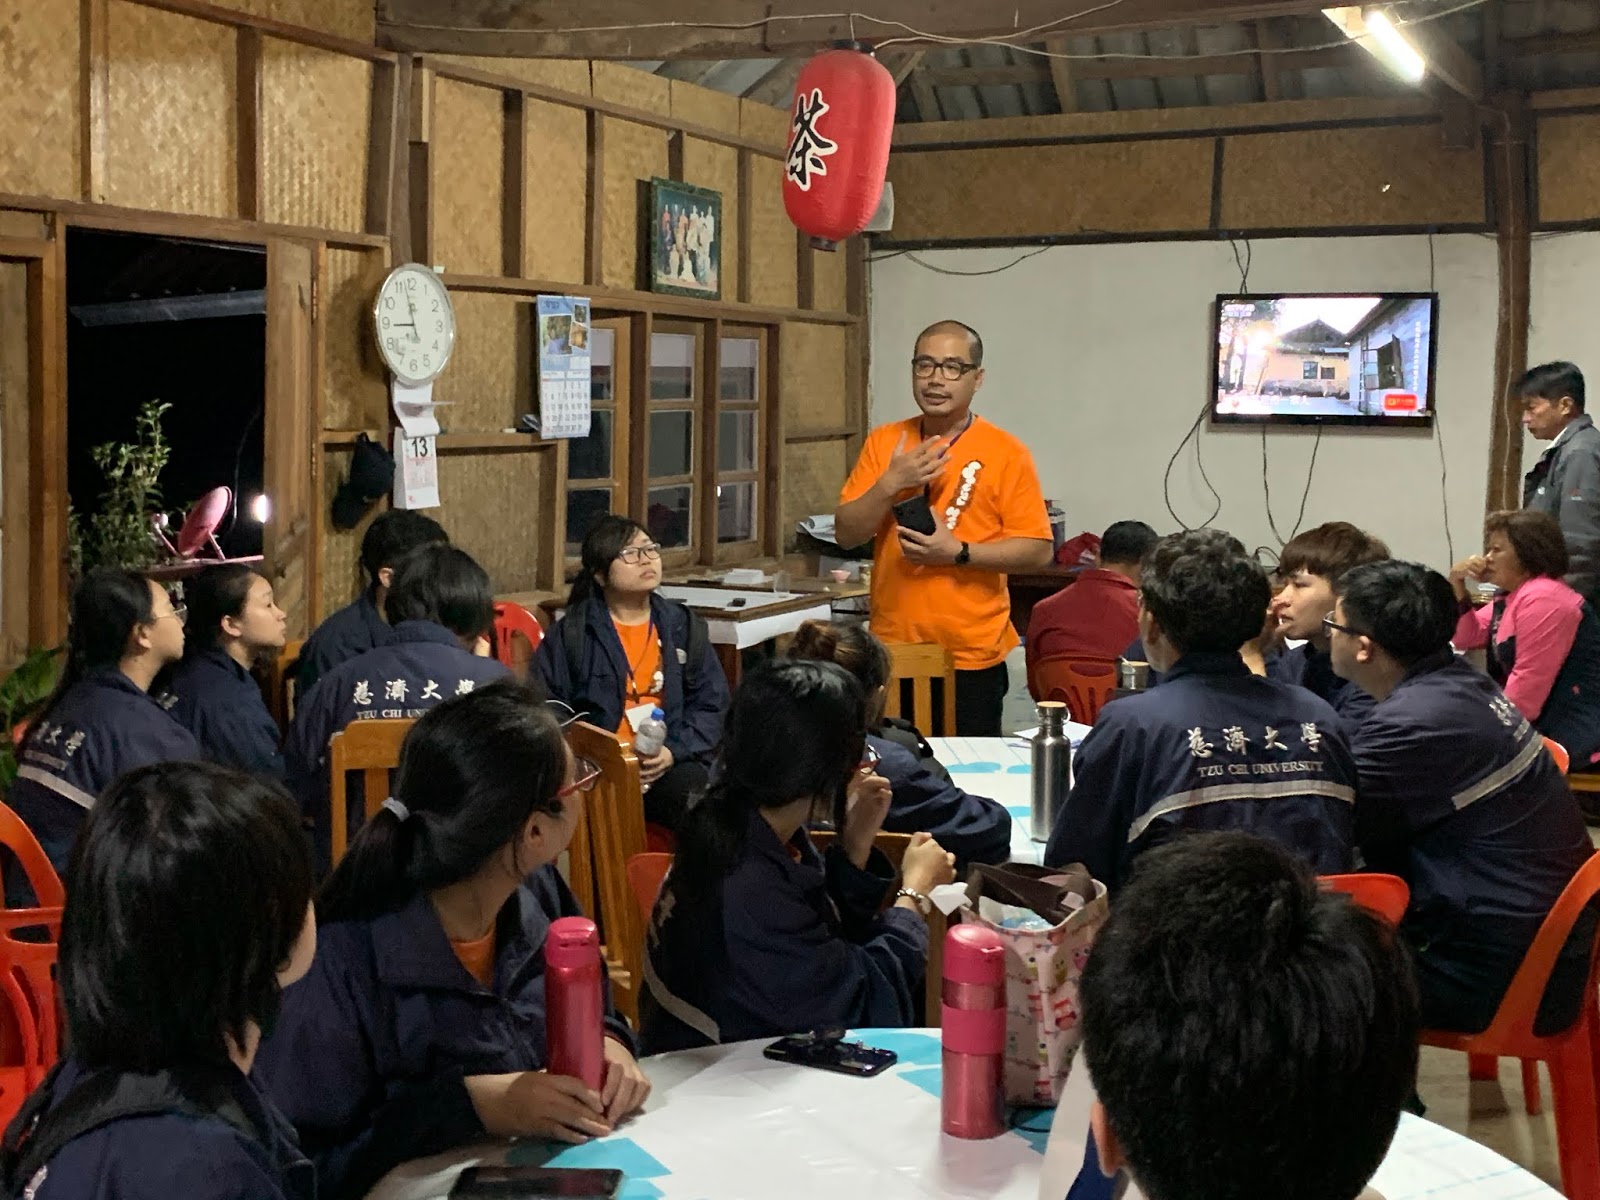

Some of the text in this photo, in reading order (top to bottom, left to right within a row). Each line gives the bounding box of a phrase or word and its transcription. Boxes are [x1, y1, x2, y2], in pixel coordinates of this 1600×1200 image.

[786, 88, 838, 191] 茶
[395, 281, 403, 293] 11
[407, 278, 417, 290] 12
[385, 297, 395, 310] 10
[432, 300, 439, 312] 2
[382, 317, 390, 329] 9
[436, 321, 443, 333] 3
[387, 337, 394, 350] 8
[432, 340, 439, 352] 4
[397, 352, 405, 364] 7
[423, 354, 430, 367] 5
[410, 359, 418, 371] 6
[412, 436, 428, 457] 13
[356, 709, 378, 720] TZU
[382, 709, 402, 718] CHI
[1187, 722, 1322, 758] 慈濟大學
[1197, 761, 1324, 778] TZU CHI UNIVERSITY
